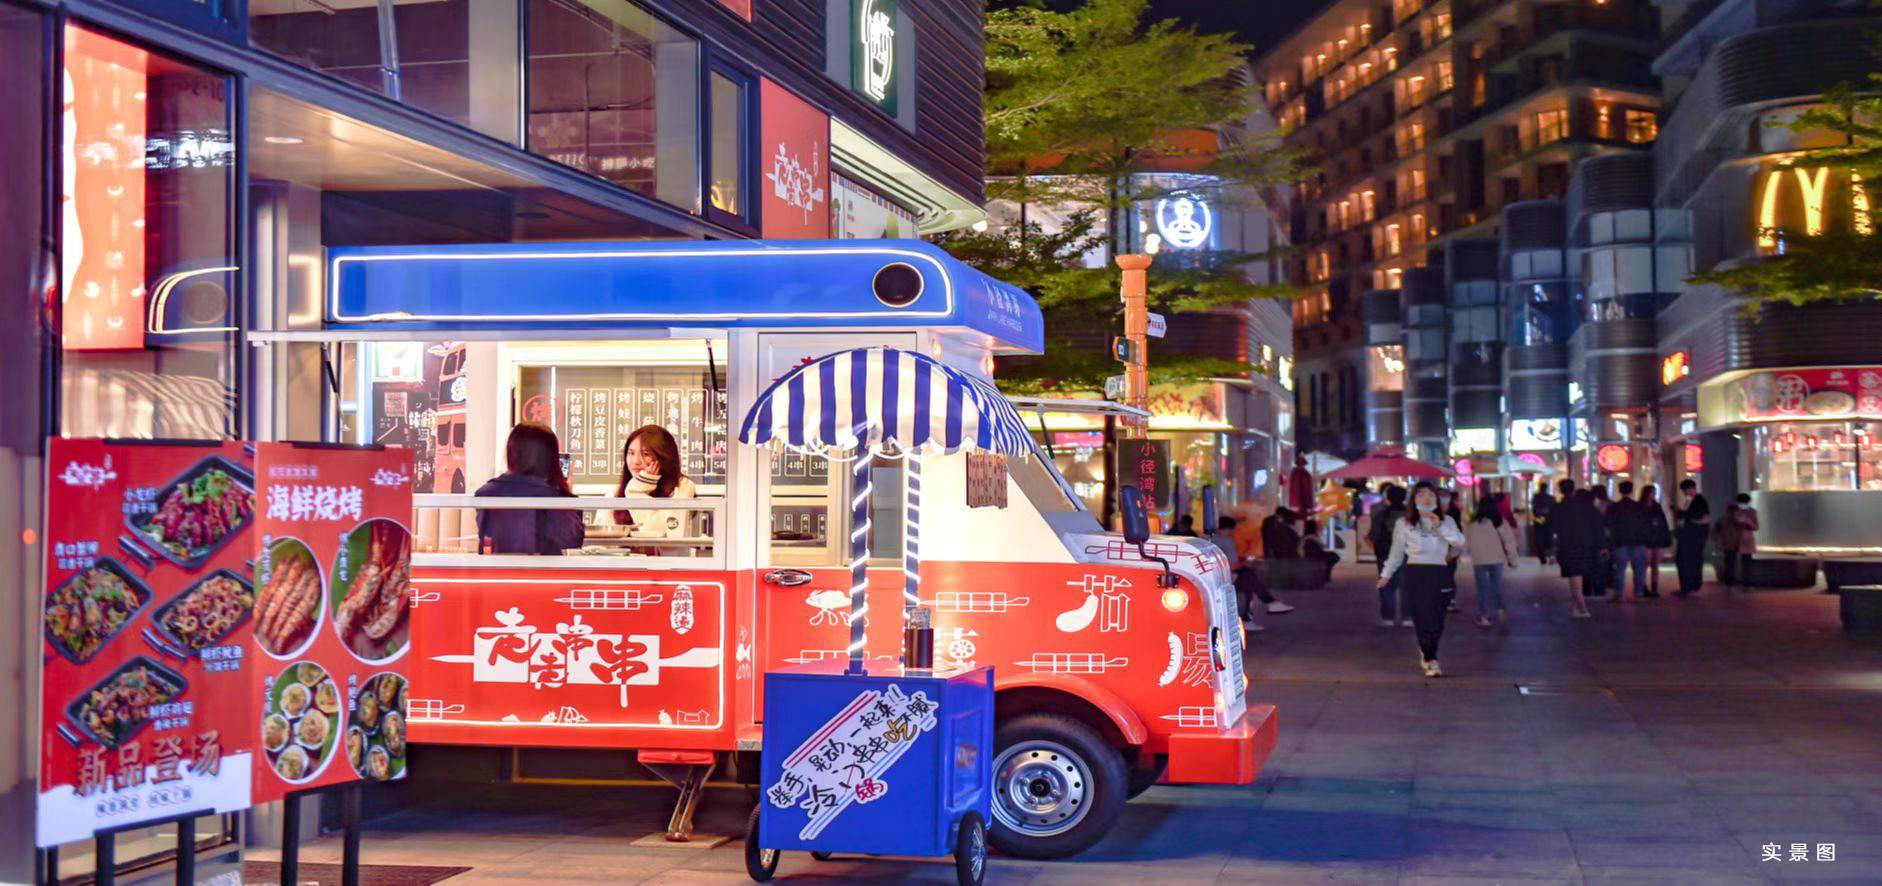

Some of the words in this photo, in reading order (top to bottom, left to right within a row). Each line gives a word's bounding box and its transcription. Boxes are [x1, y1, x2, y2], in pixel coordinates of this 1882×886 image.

[266, 484, 363, 521] 海鲜烧烤
[73, 730, 223, 798] 新品登场
